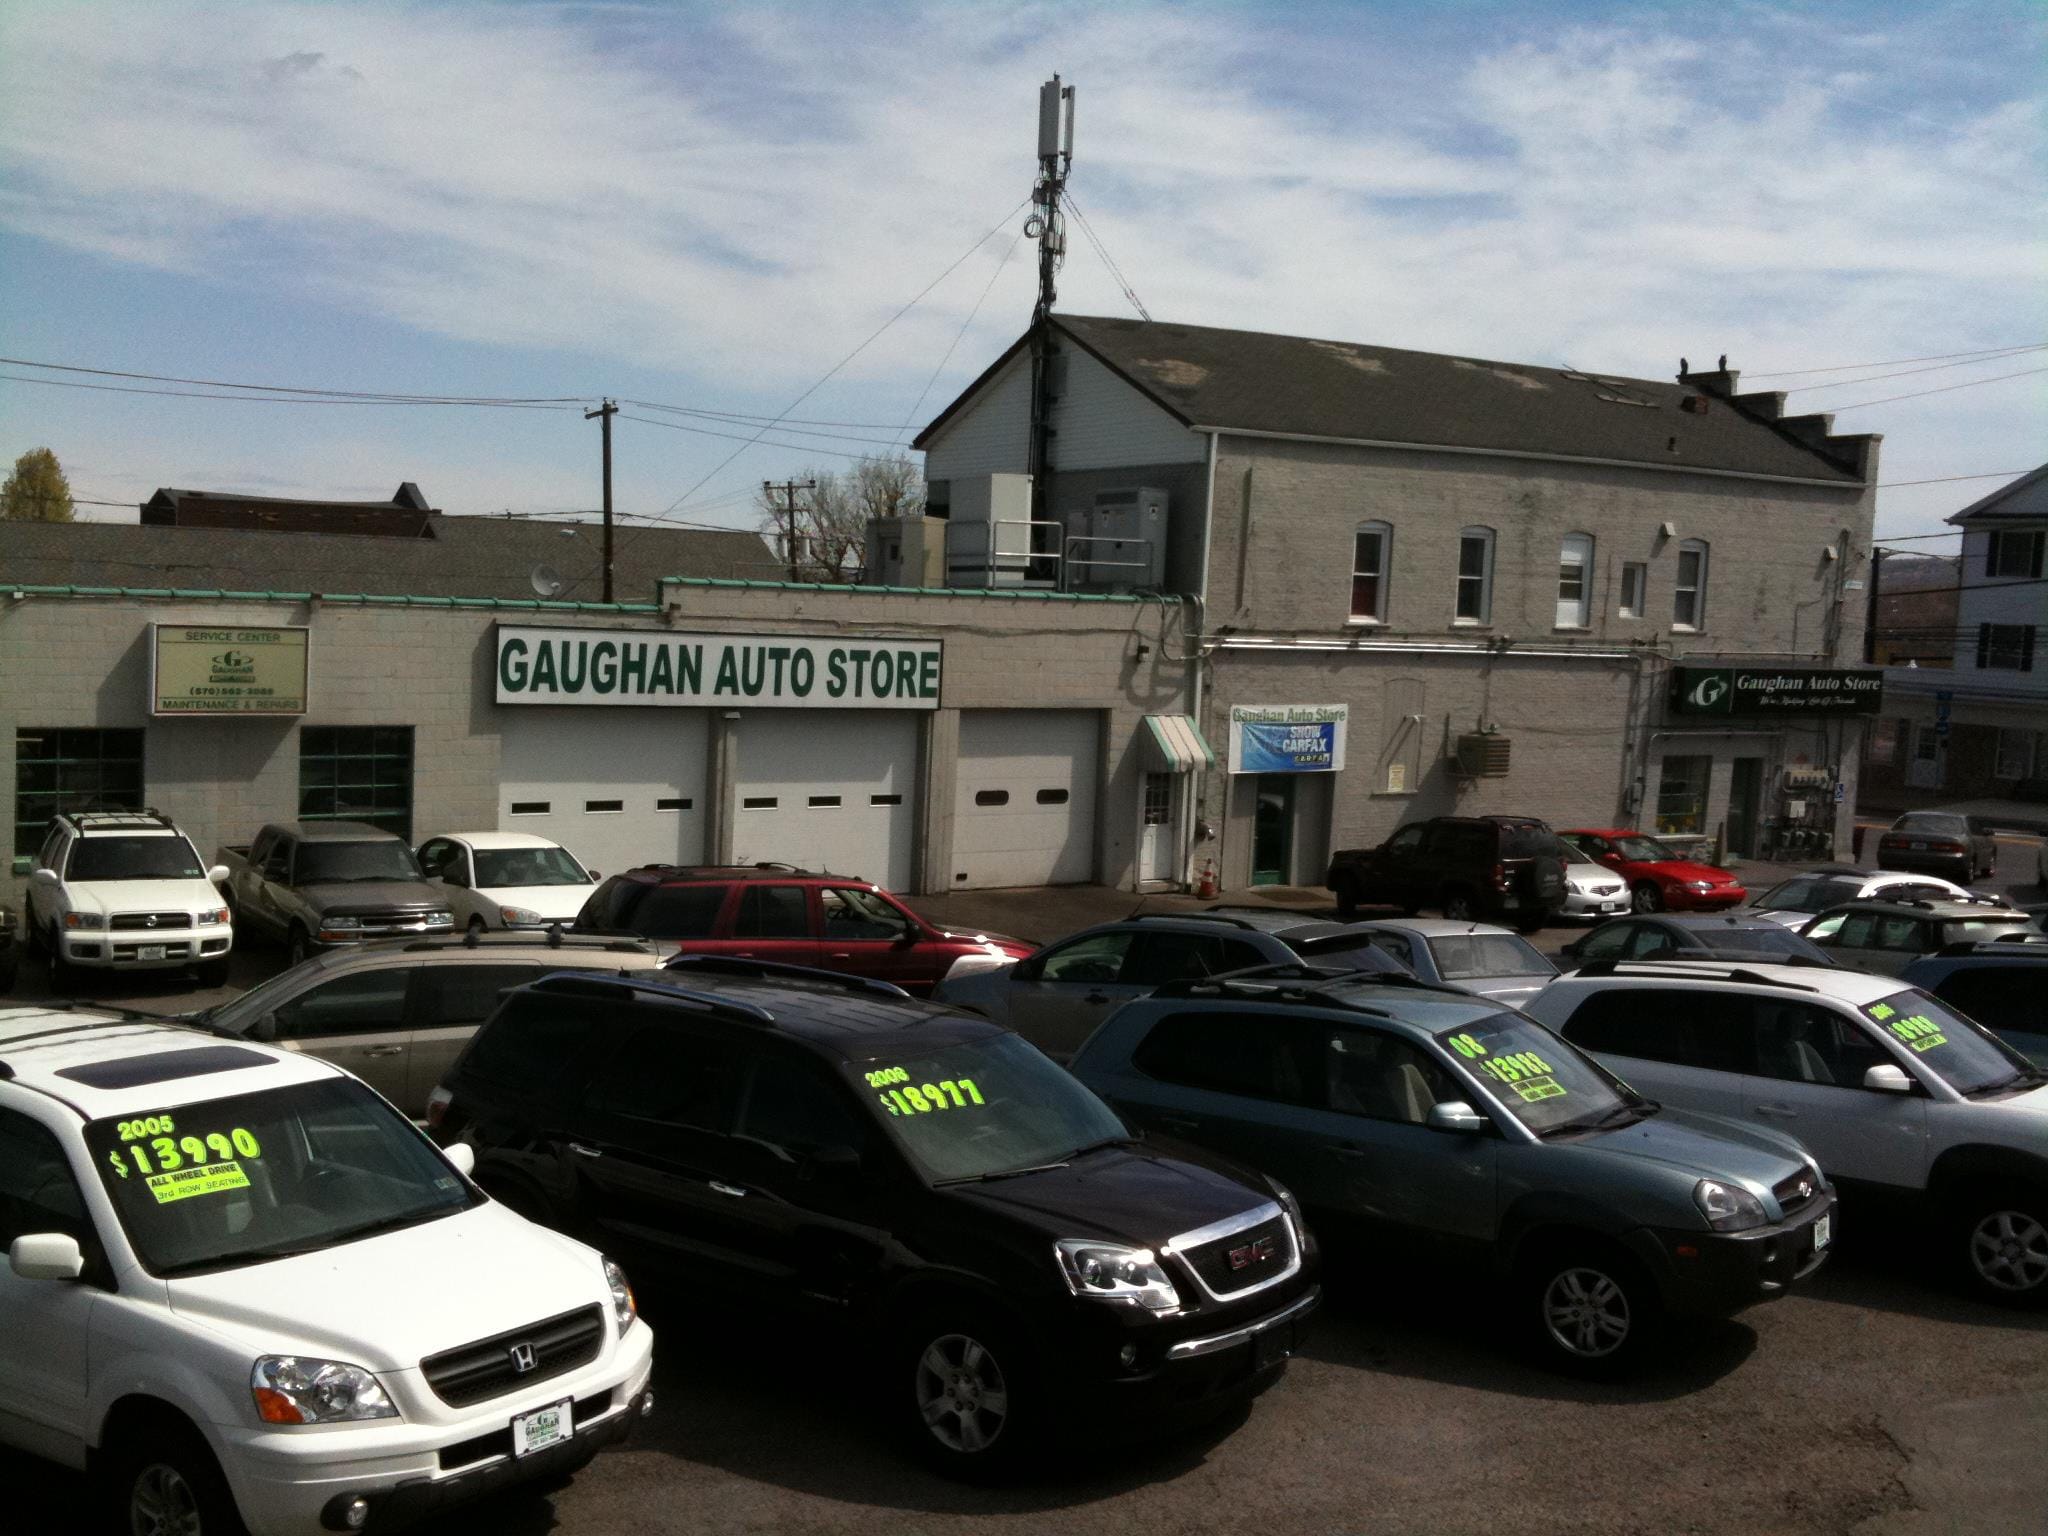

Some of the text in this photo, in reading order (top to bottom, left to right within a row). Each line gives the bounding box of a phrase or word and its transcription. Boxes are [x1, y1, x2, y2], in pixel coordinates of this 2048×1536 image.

[186, 631, 281, 642] SERVICE CENTER
[500, 638, 940, 699] GAUGHAN AUTO STORE
[1738, 675, 1881, 693] Gaughan Auto Store
[162, 700, 240, 709] MAINTENANCE
[256, 701, 299, 709] REPAIRS
[1286, 708, 1314, 722] Auto
[1316, 708, 1346, 721] Store
[1290, 726, 1321, 739] SHOW
[1282, 739, 1328, 752] CARFAX
[1448, 1033, 1488, 1059] 08
[879, 1079, 985, 1116] $18977
[117, 1115, 175, 1141] 2005
[110, 1128, 261, 1179] $13990
[151, 1163, 238, 1187] ALL WHEEL DRIVE
[157, 1177, 247, 1200] 3rd ROW SEATING
